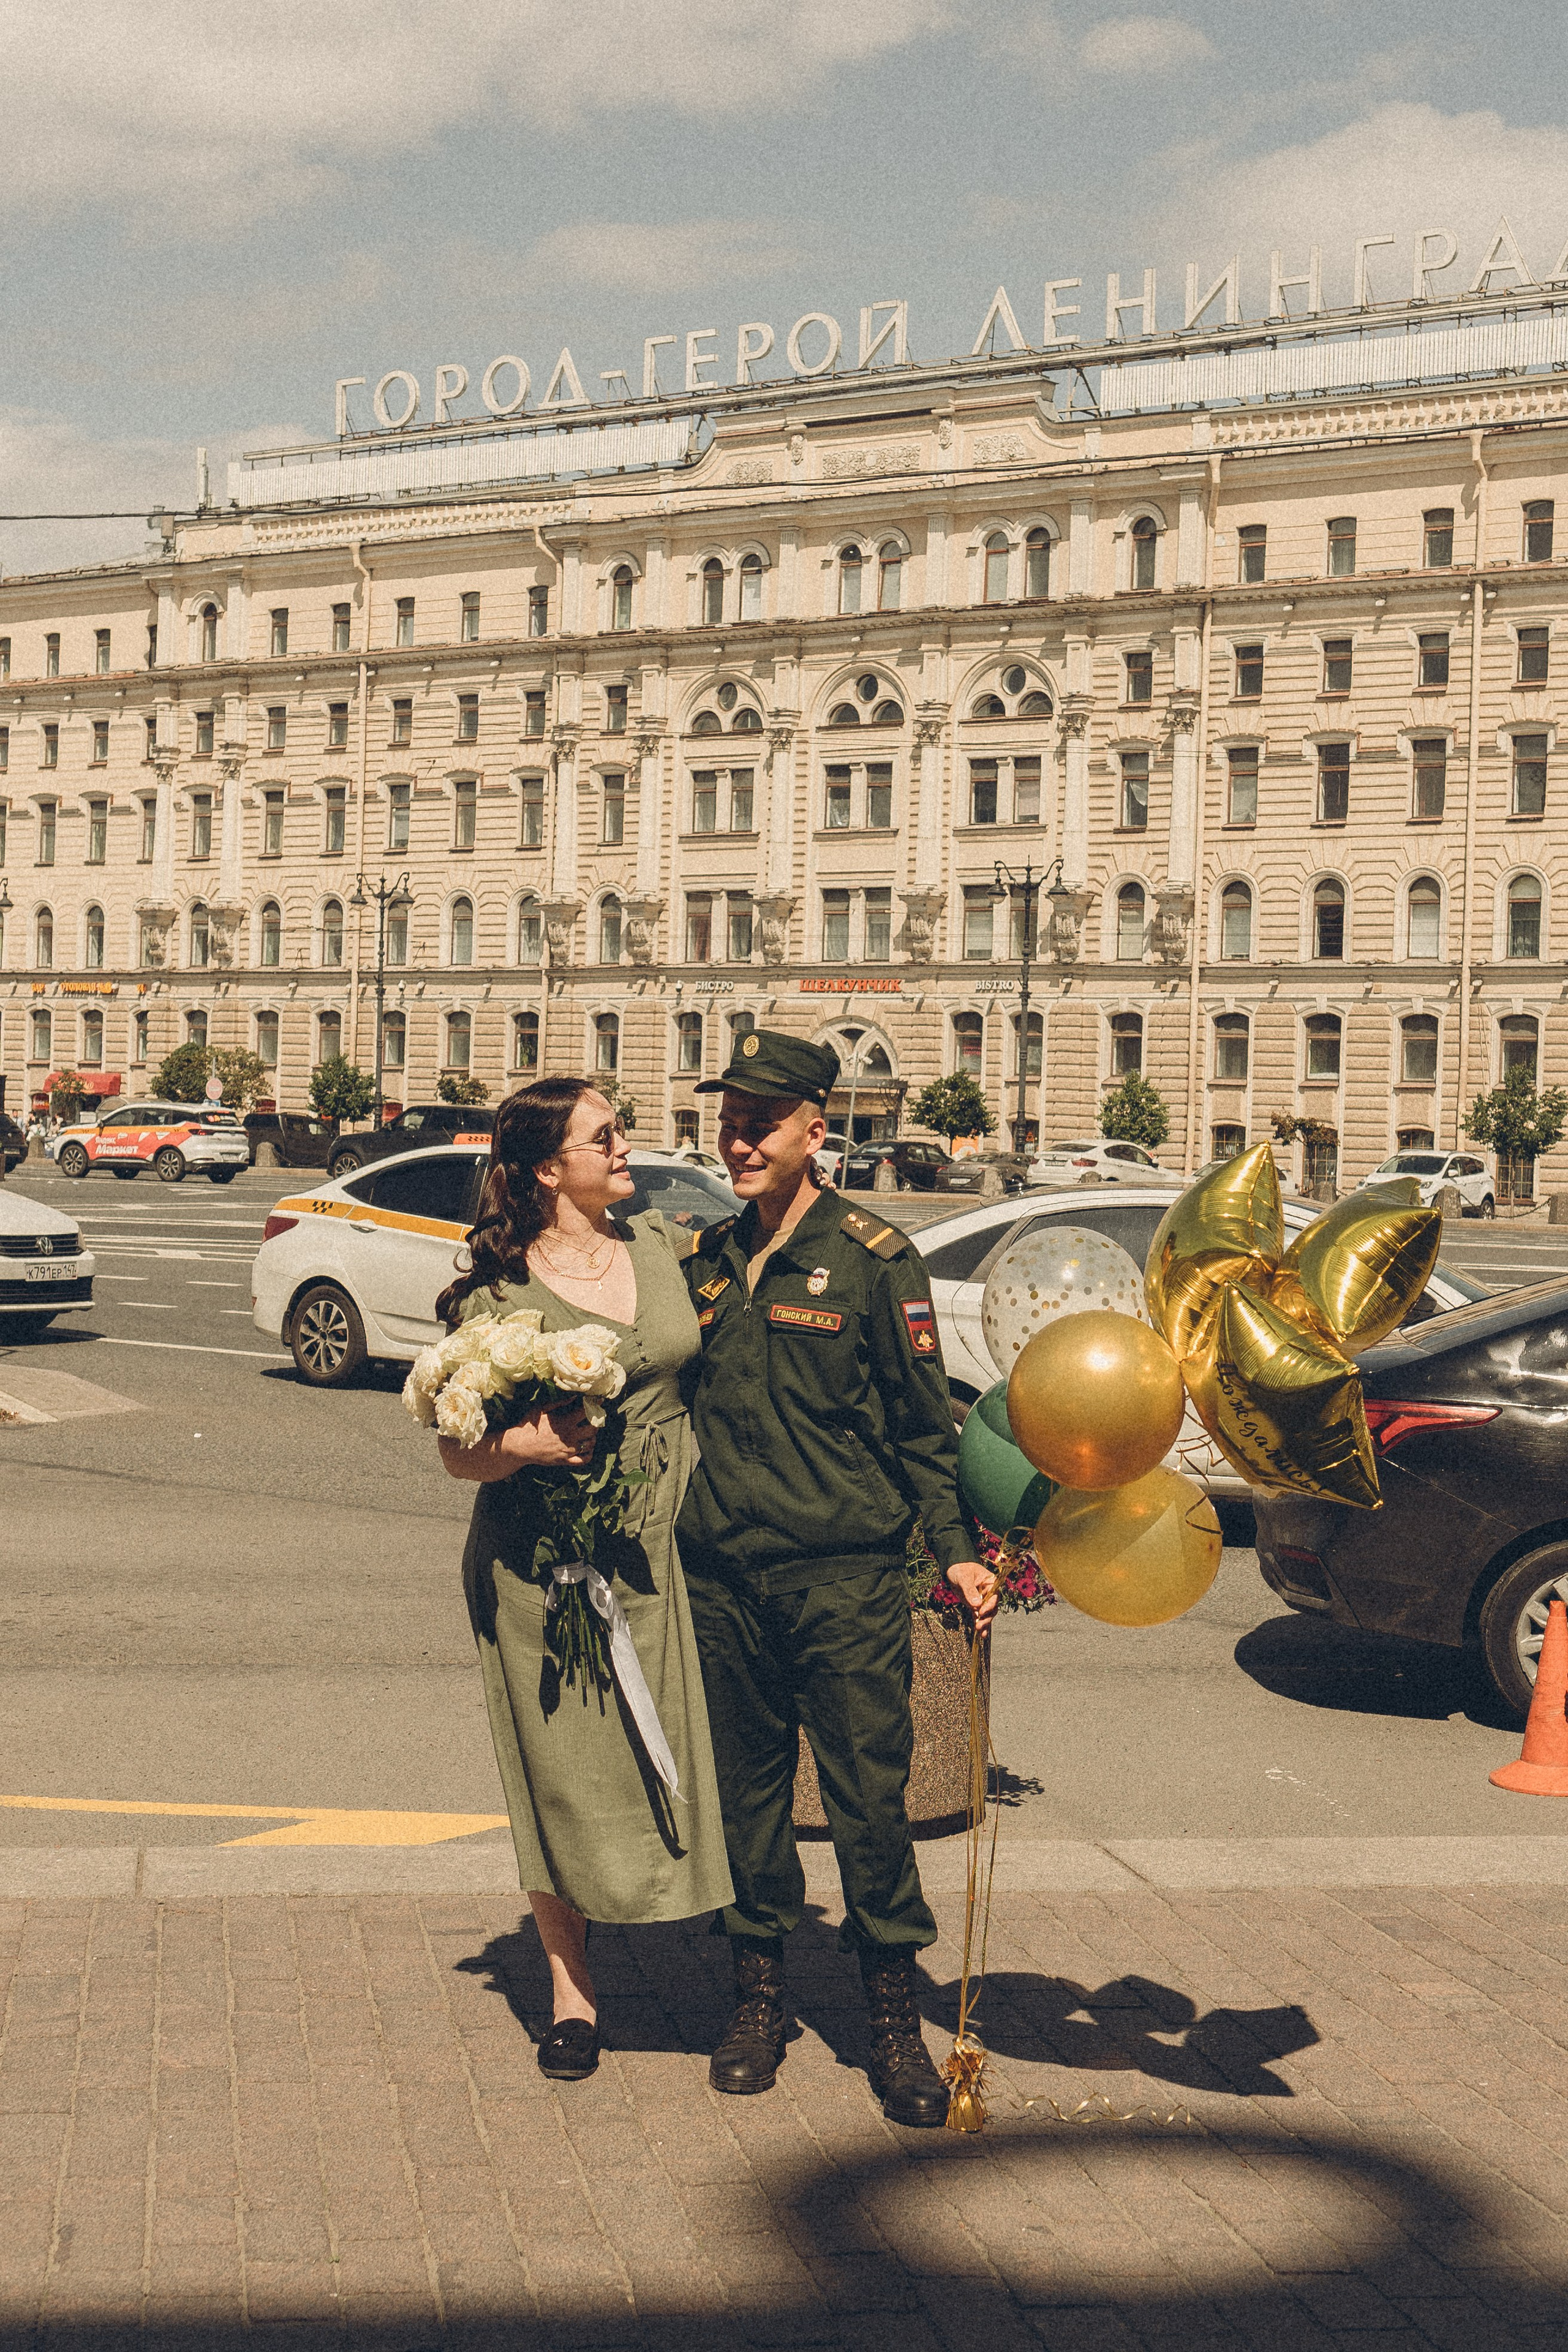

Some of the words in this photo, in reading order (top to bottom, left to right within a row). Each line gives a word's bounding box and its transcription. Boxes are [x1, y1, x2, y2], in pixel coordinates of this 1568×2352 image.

[336, 300, 908, 435] ГОРОД-ГЕРОЙ
[695, 981, 734, 990] БИСТРО
[799, 979, 903, 992] ЩЕЛКУНЧИК
[976, 980, 1014, 990] BISTRO
[95, 1136, 116, 1145] Яндекс
[95, 1145, 139, 1155] Маркет
[777, 1310, 812, 1322] ГОНСКИЙ
[816, 1316, 834, 1326] М.А.
[1213, 1361, 1327, 1493] Дождались!
